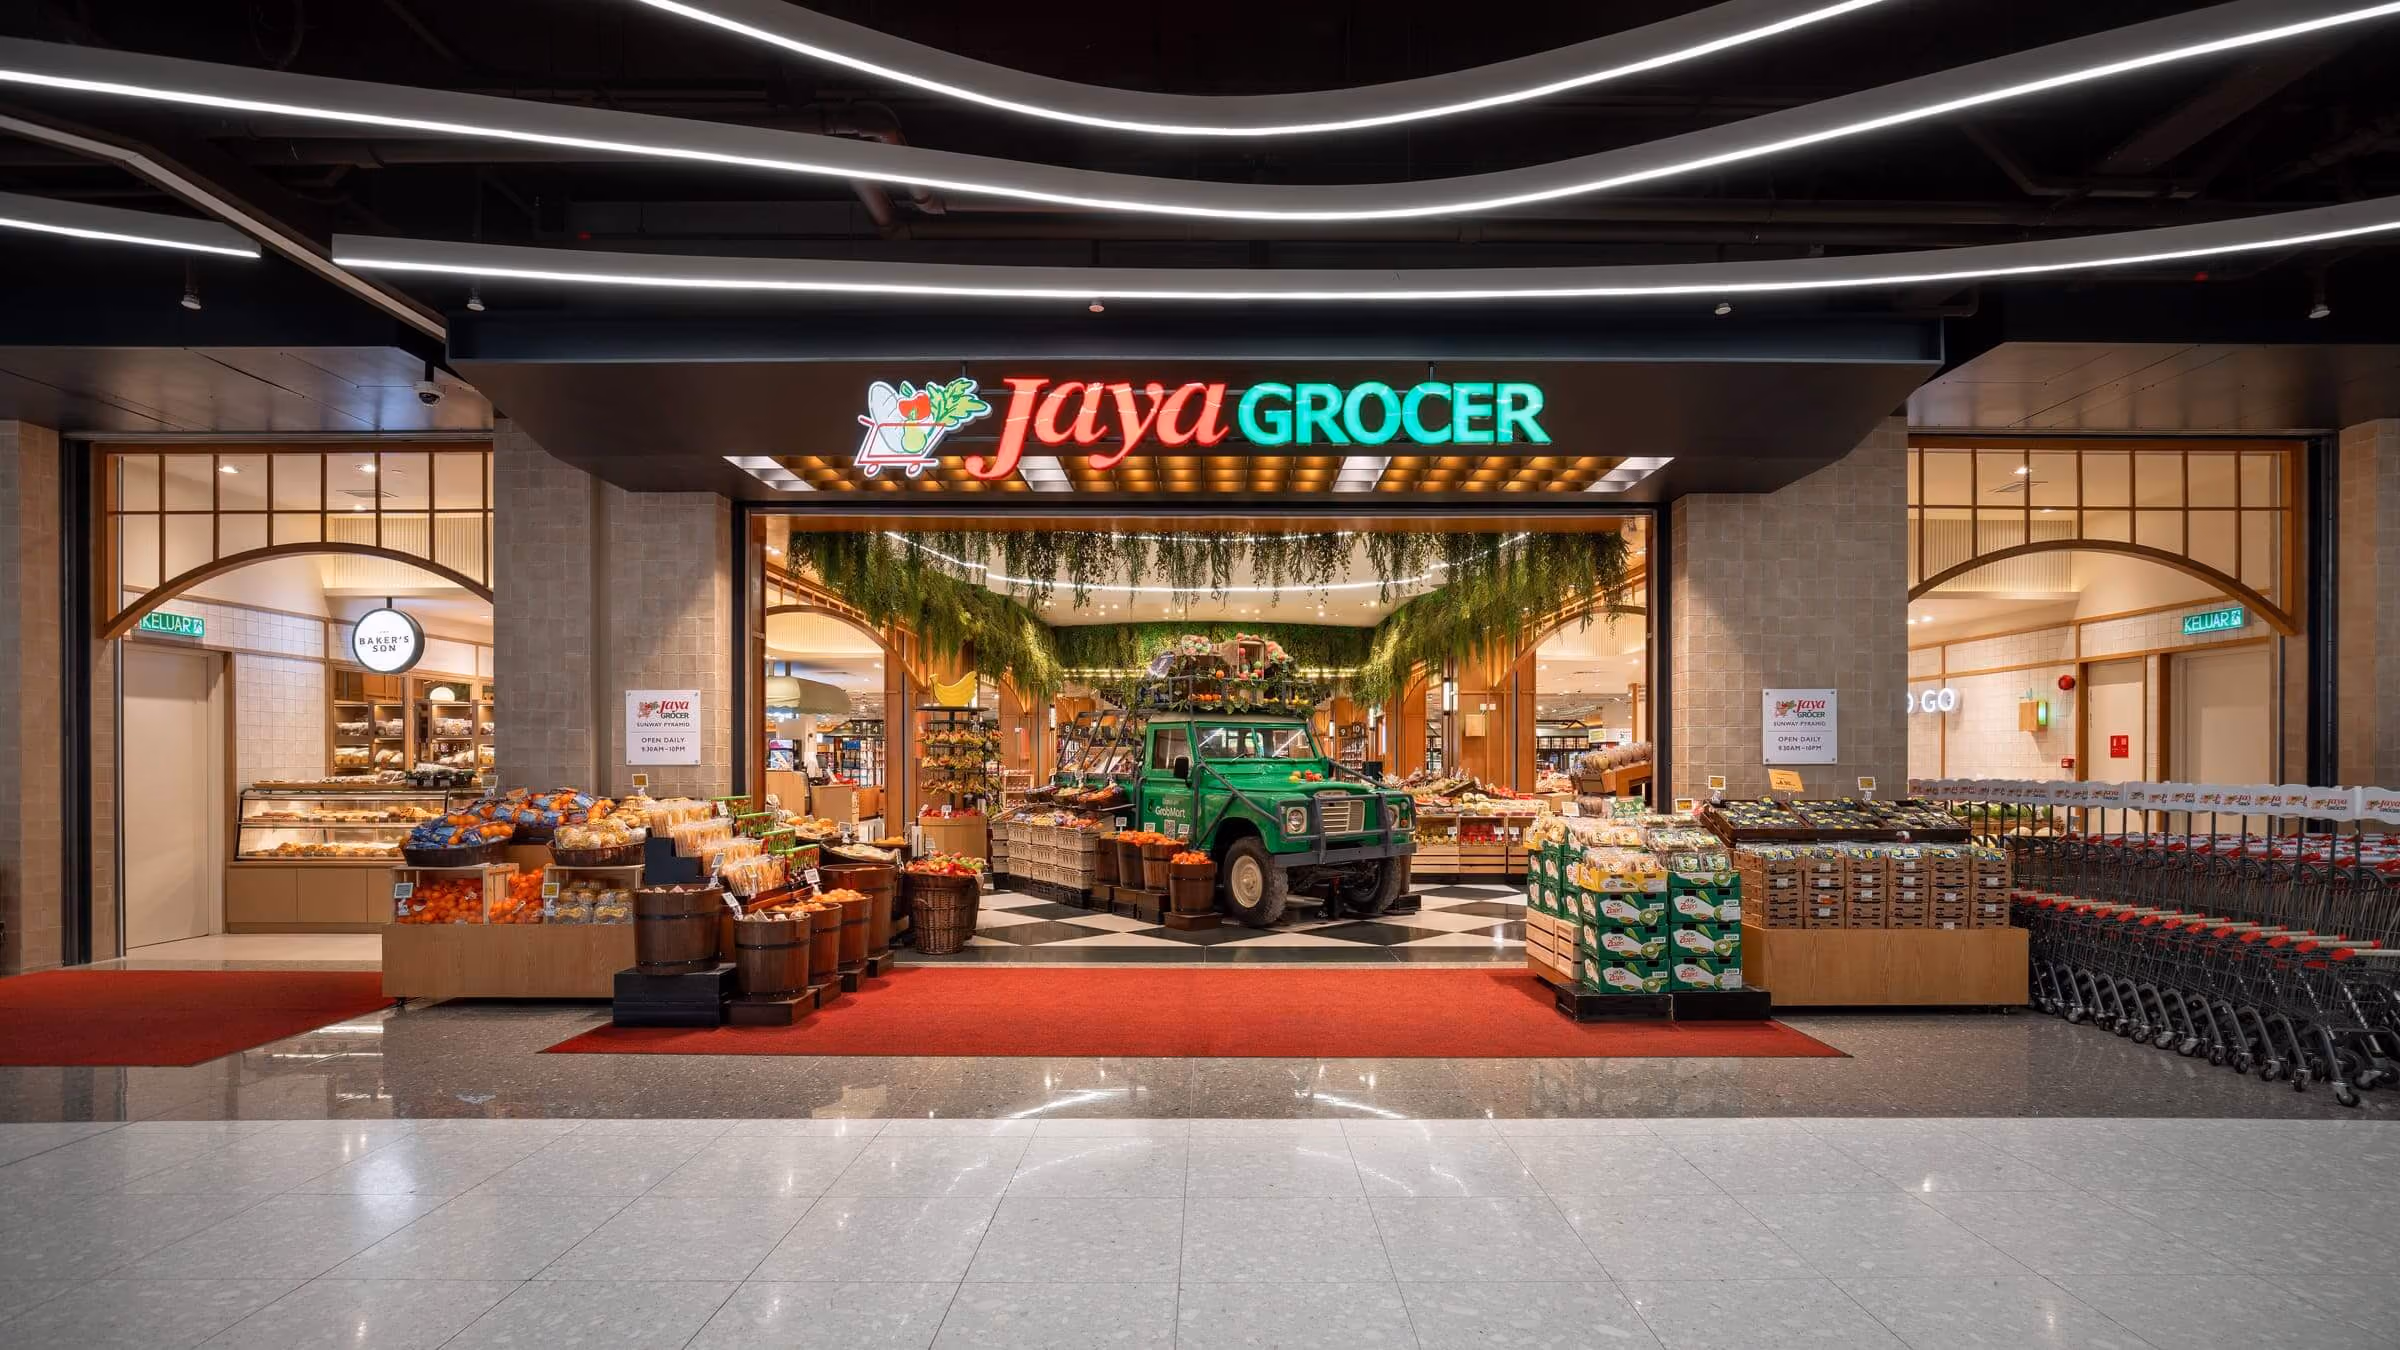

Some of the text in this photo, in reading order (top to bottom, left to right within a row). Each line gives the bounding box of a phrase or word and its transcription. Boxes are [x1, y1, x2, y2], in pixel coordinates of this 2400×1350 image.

[963, 376, 1552, 481] Jaya GROCER
[142, 613, 191, 633] KELUAR
[2183, 612, 2230, 632] KELUAR
[359, 635, 410, 646] BAKER'S
[372, 644, 397, 653] SON
[656, 700, 690, 714] Jaya
[1793, 699, 1826, 713] Jaya
[1921, 687, 1955, 713] GO
